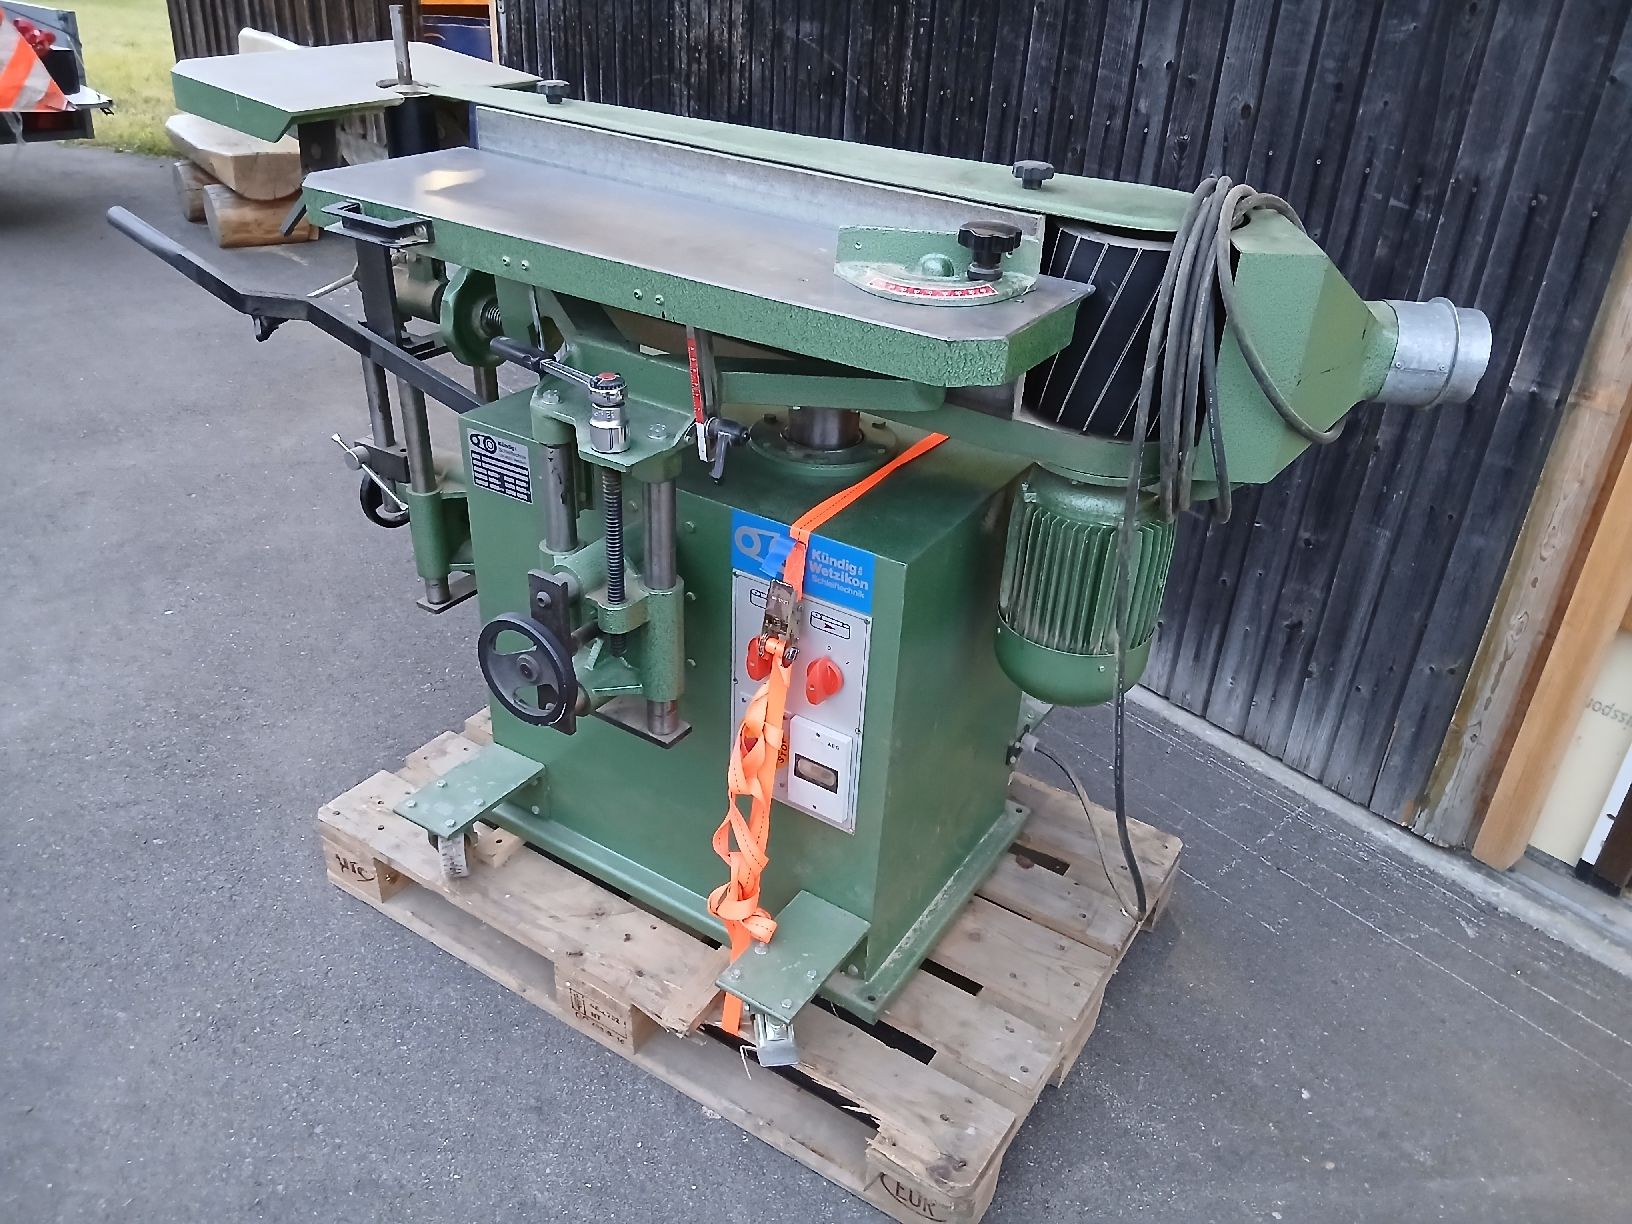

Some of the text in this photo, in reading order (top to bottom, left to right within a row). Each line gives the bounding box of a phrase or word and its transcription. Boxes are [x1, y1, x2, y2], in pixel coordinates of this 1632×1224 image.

[809, 560, 869, 591] Wetzikon
[811, 549, 857, 576] Kündig
[827, 742, 840, 751] AEG
